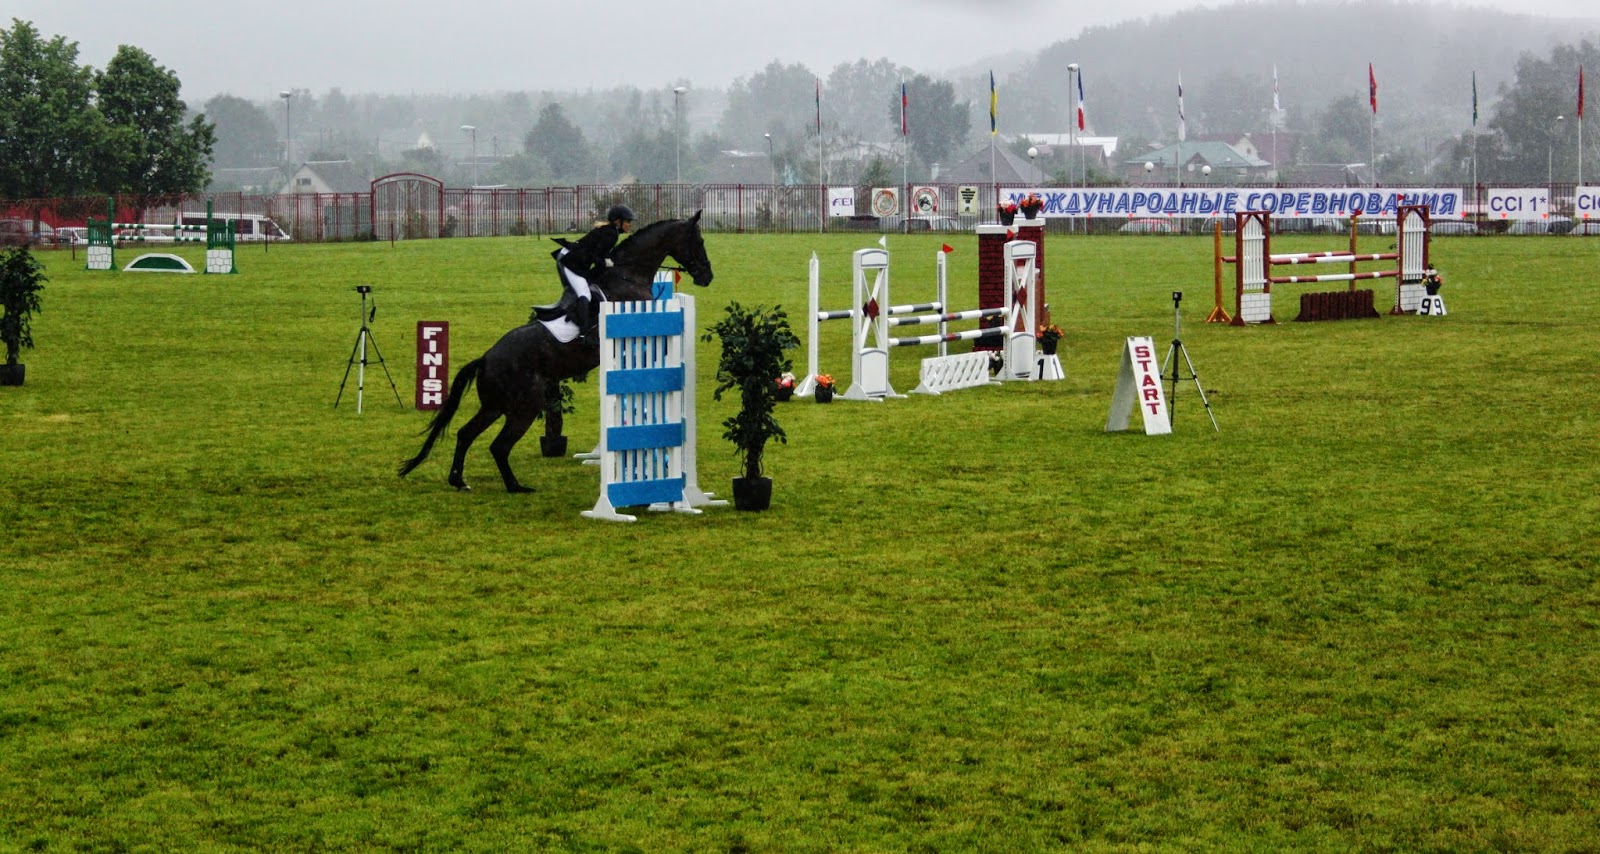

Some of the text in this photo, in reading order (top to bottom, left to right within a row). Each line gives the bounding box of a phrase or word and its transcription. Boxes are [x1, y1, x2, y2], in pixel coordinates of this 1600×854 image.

[1008, 192, 1239, 214] МЖДУНАРОДНЫЕ
[1490, 196, 1522, 212] CCI
[1578, 194, 1600, 210] CI
[422, 326, 443, 405] FINISH
[1037, 358, 1045, 380] 1
[1134, 345, 1161, 415] START
